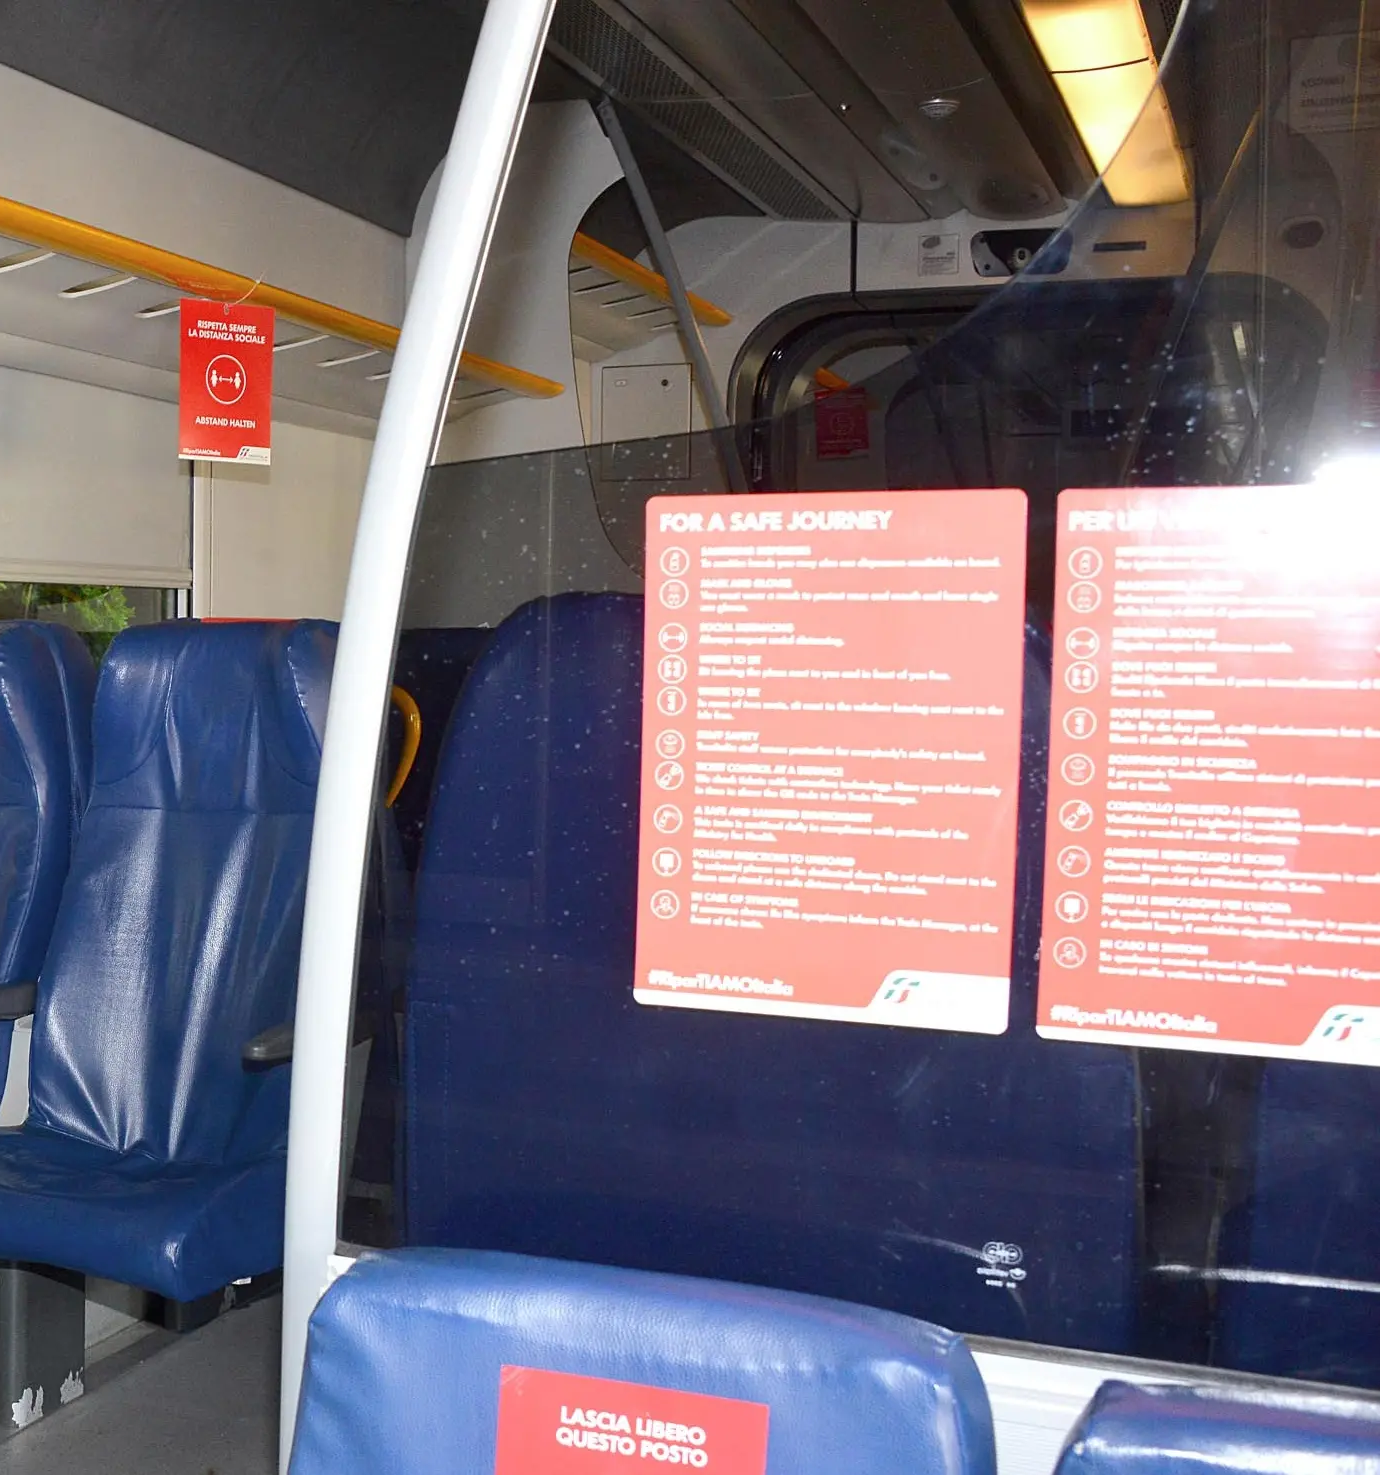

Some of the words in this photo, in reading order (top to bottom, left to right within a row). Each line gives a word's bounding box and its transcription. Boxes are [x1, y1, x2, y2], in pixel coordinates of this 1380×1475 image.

[188, 328, 198, 337] LA
[198, 329, 234, 341] DISTANZA
[235, 333, 266, 345] SOCIALE
[197, 319, 228, 333] RISPETTA
[228, 323, 257, 334] SEMPRE
[195, 415, 229, 428] ABSTAND
[229, 418, 256, 429] HALTEN
[659, 512, 705, 533] FOR
[707, 512, 727, 532] A
[729, 511, 783, 532] SAFE
[787, 509, 893, 532] JOURNEY
[1068, 510, 1115, 532] PER
[560, 1405, 631, 1434] LASCIA
[635, 1416, 707, 1446] LIBERO
[555, 1426, 636, 1456] QUESTO
[640, 1439, 709, 1468] POSTO
